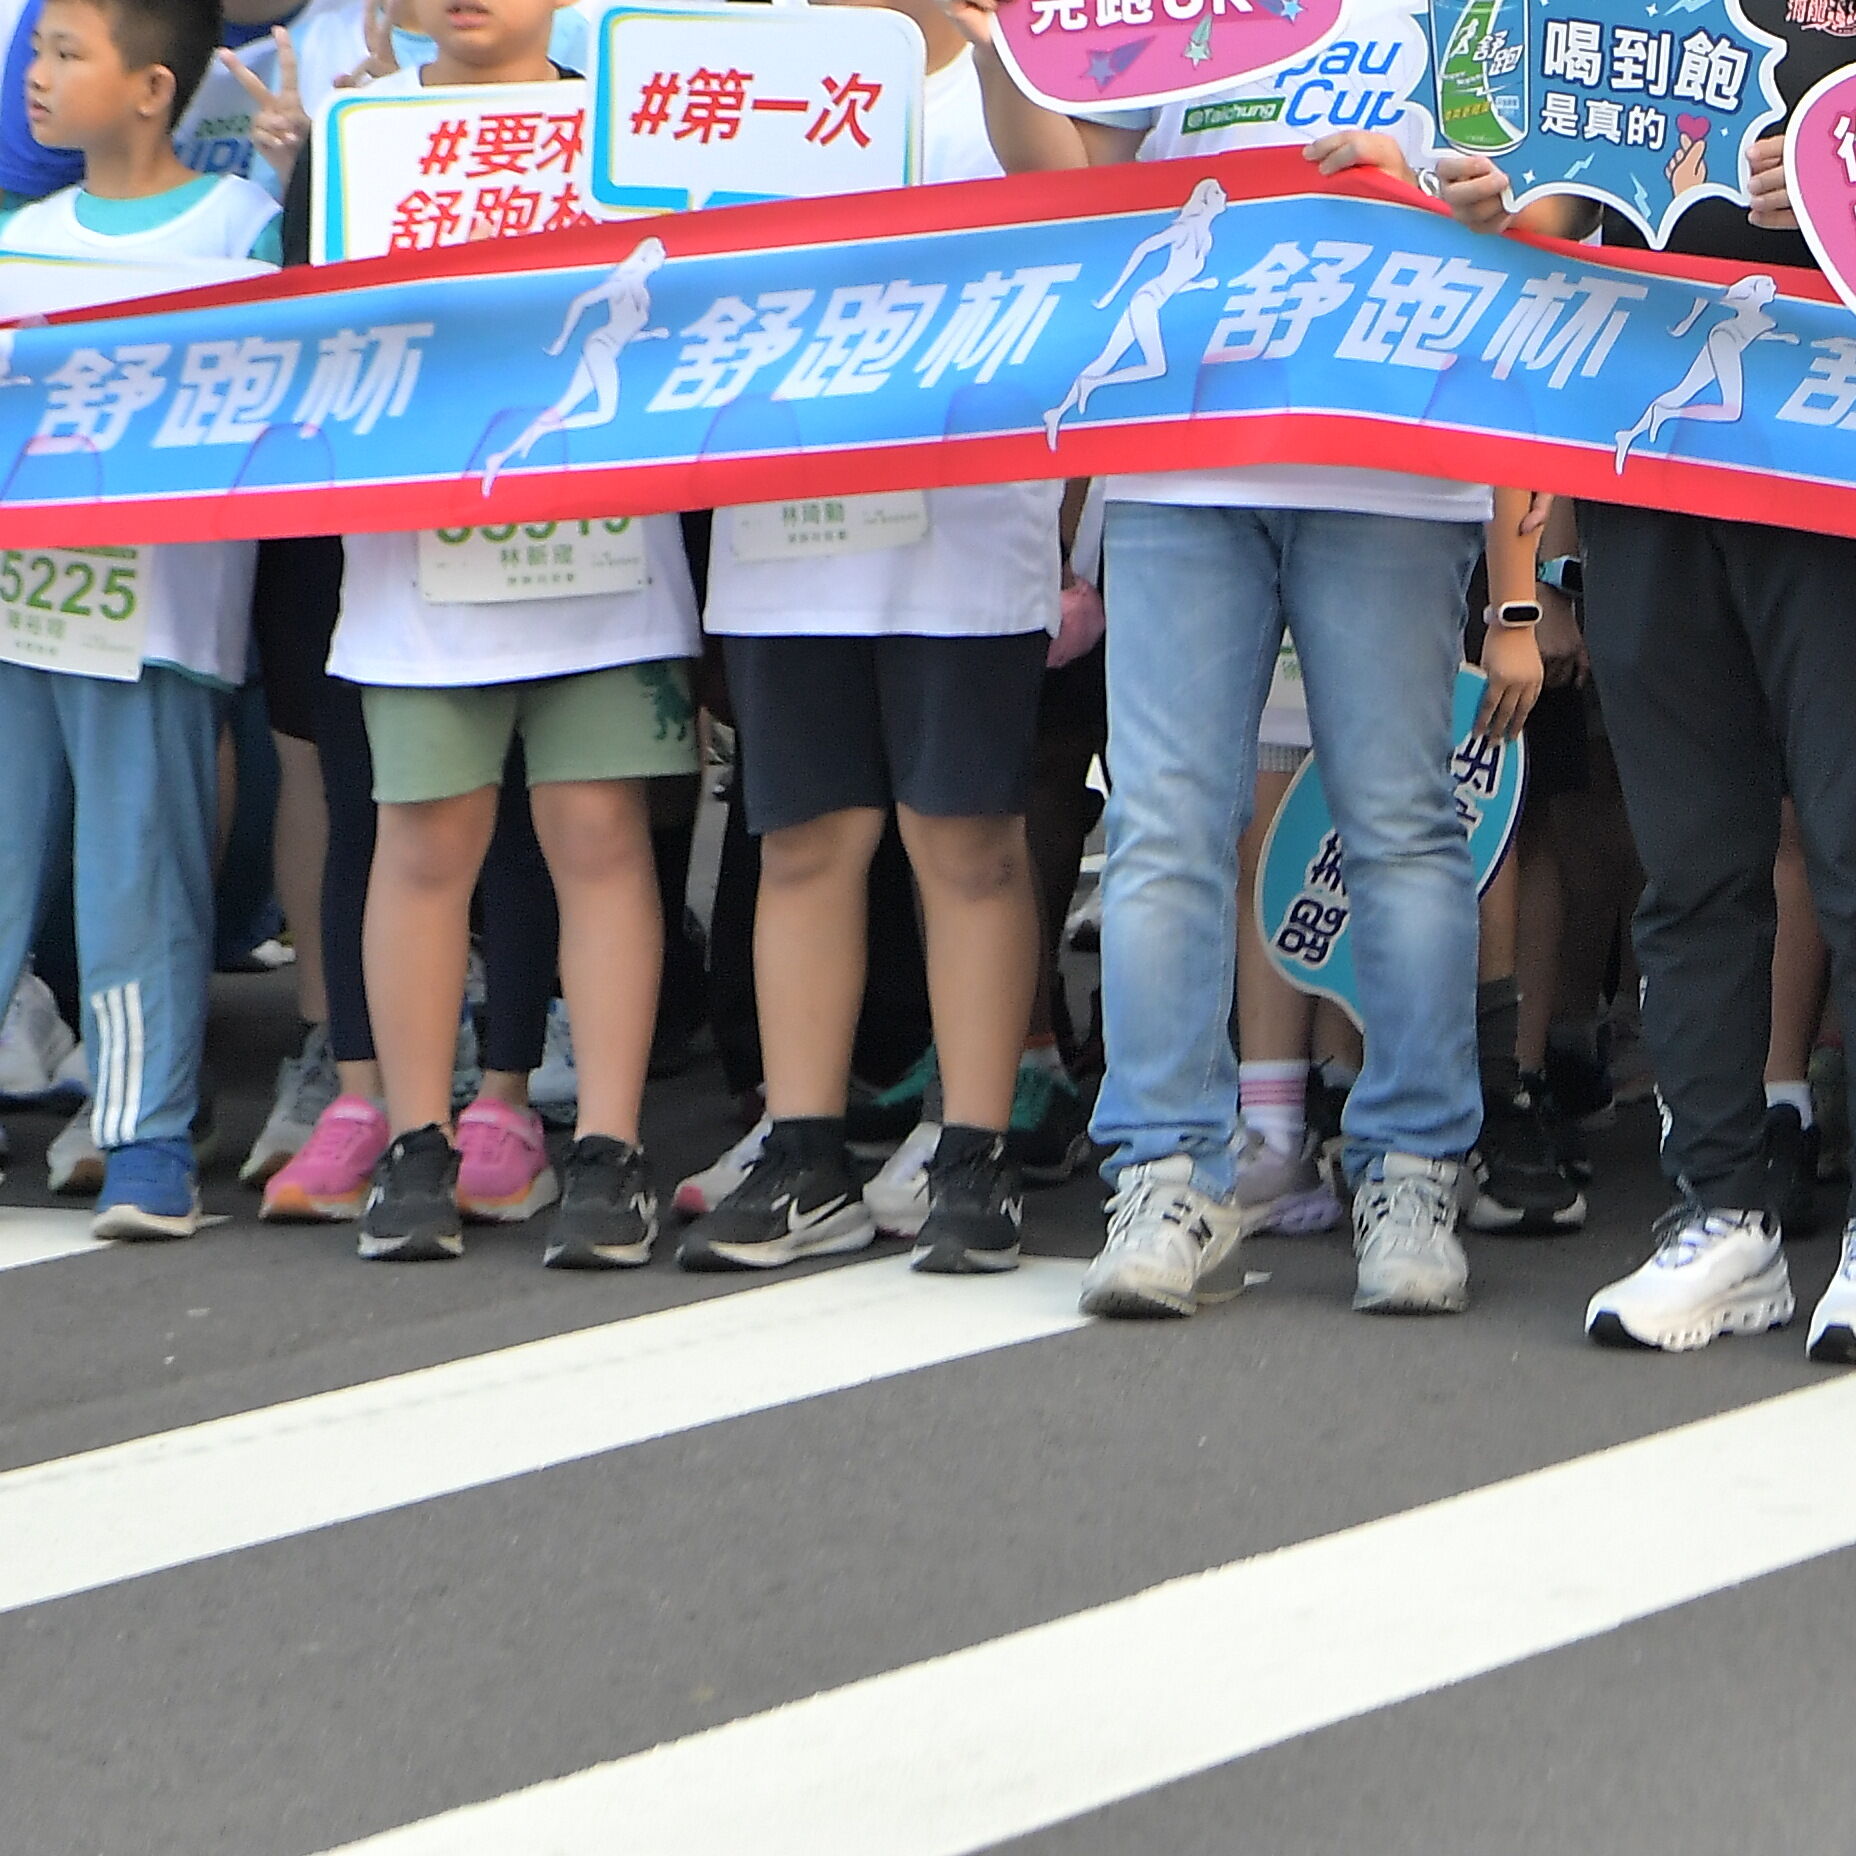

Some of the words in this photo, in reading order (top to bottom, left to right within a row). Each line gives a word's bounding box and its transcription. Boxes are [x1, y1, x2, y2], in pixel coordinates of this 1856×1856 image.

[1472, 29, 1524, 77] 舒跑
[1540, 17, 1750, 112] 喝到飽
[629, 65, 884, 147] #第一次
[1541, 91, 1665, 150] 是真的
[645, 262, 1083, 413] 舒跑杯
[1198, 239, 1649, 391] 舒跑杯
[28, 320, 435, 456] 舒跑杯
